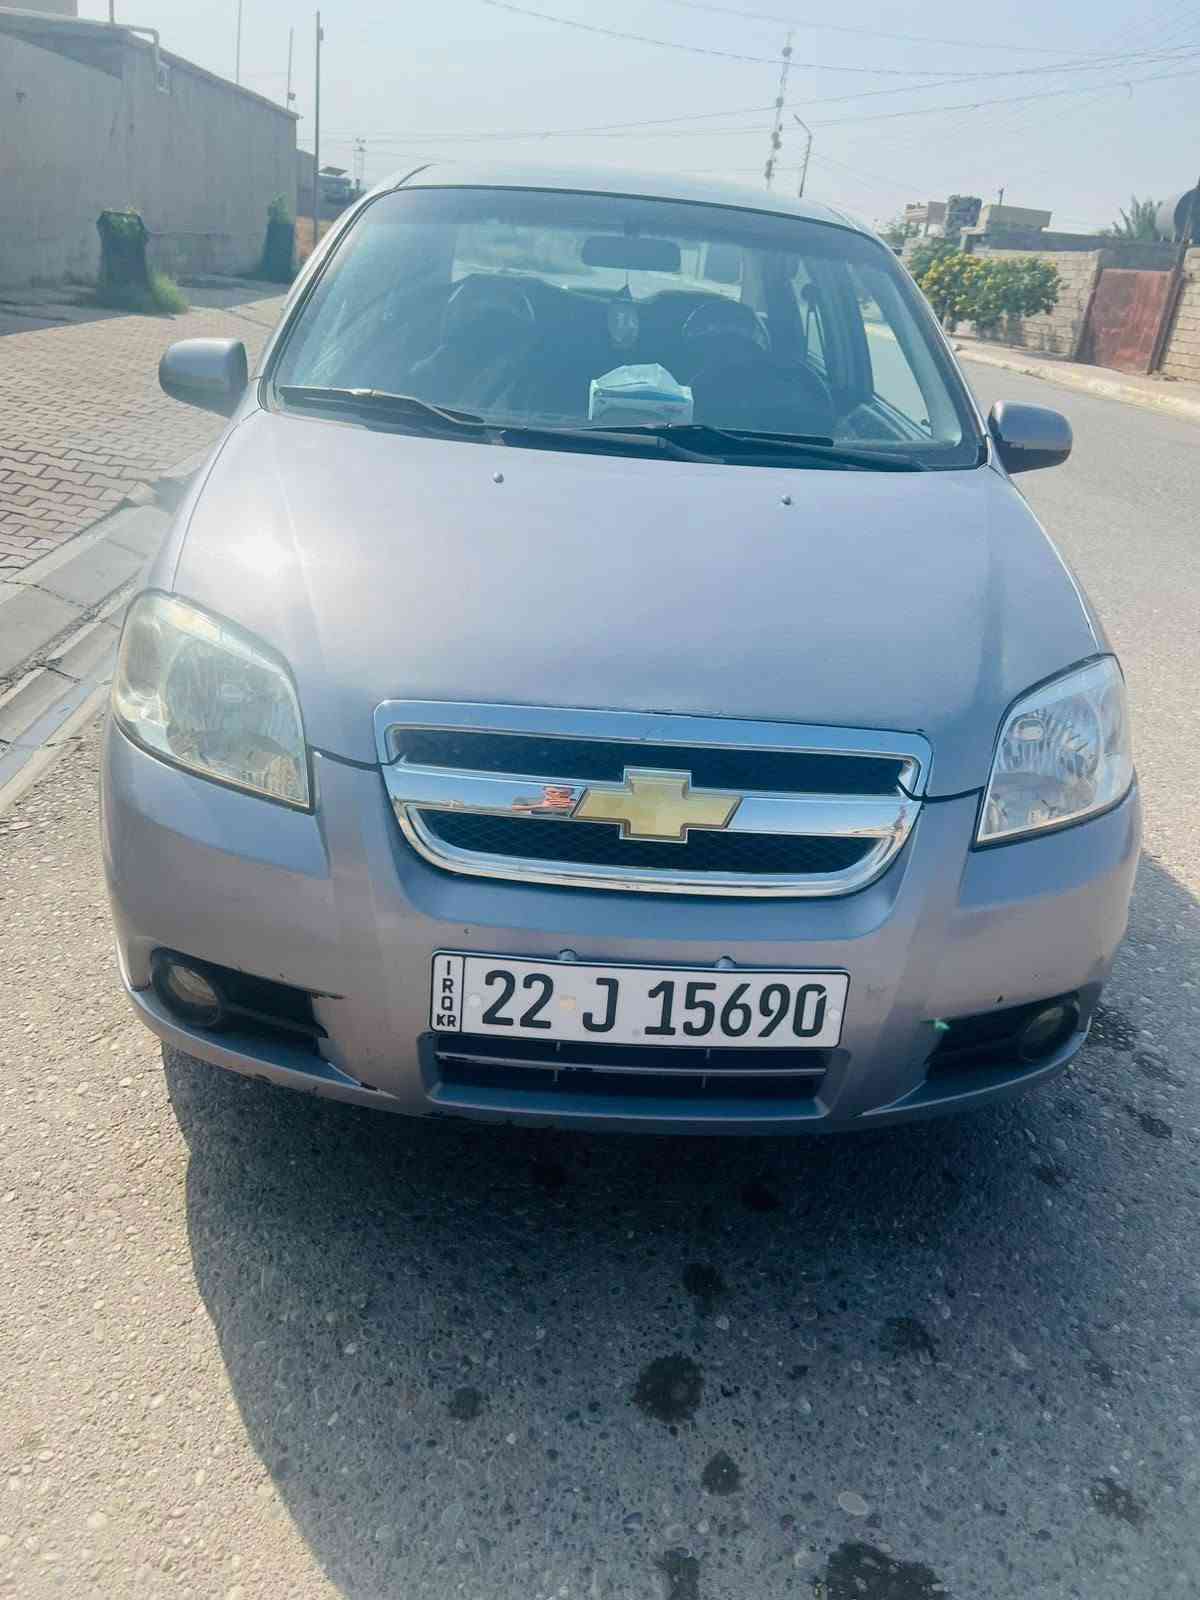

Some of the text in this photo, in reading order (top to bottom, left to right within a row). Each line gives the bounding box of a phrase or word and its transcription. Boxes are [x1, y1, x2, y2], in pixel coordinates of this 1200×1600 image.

[436, 1013, 457, 1028] KR
[482, 969, 828, 1038] 22 J 15690
